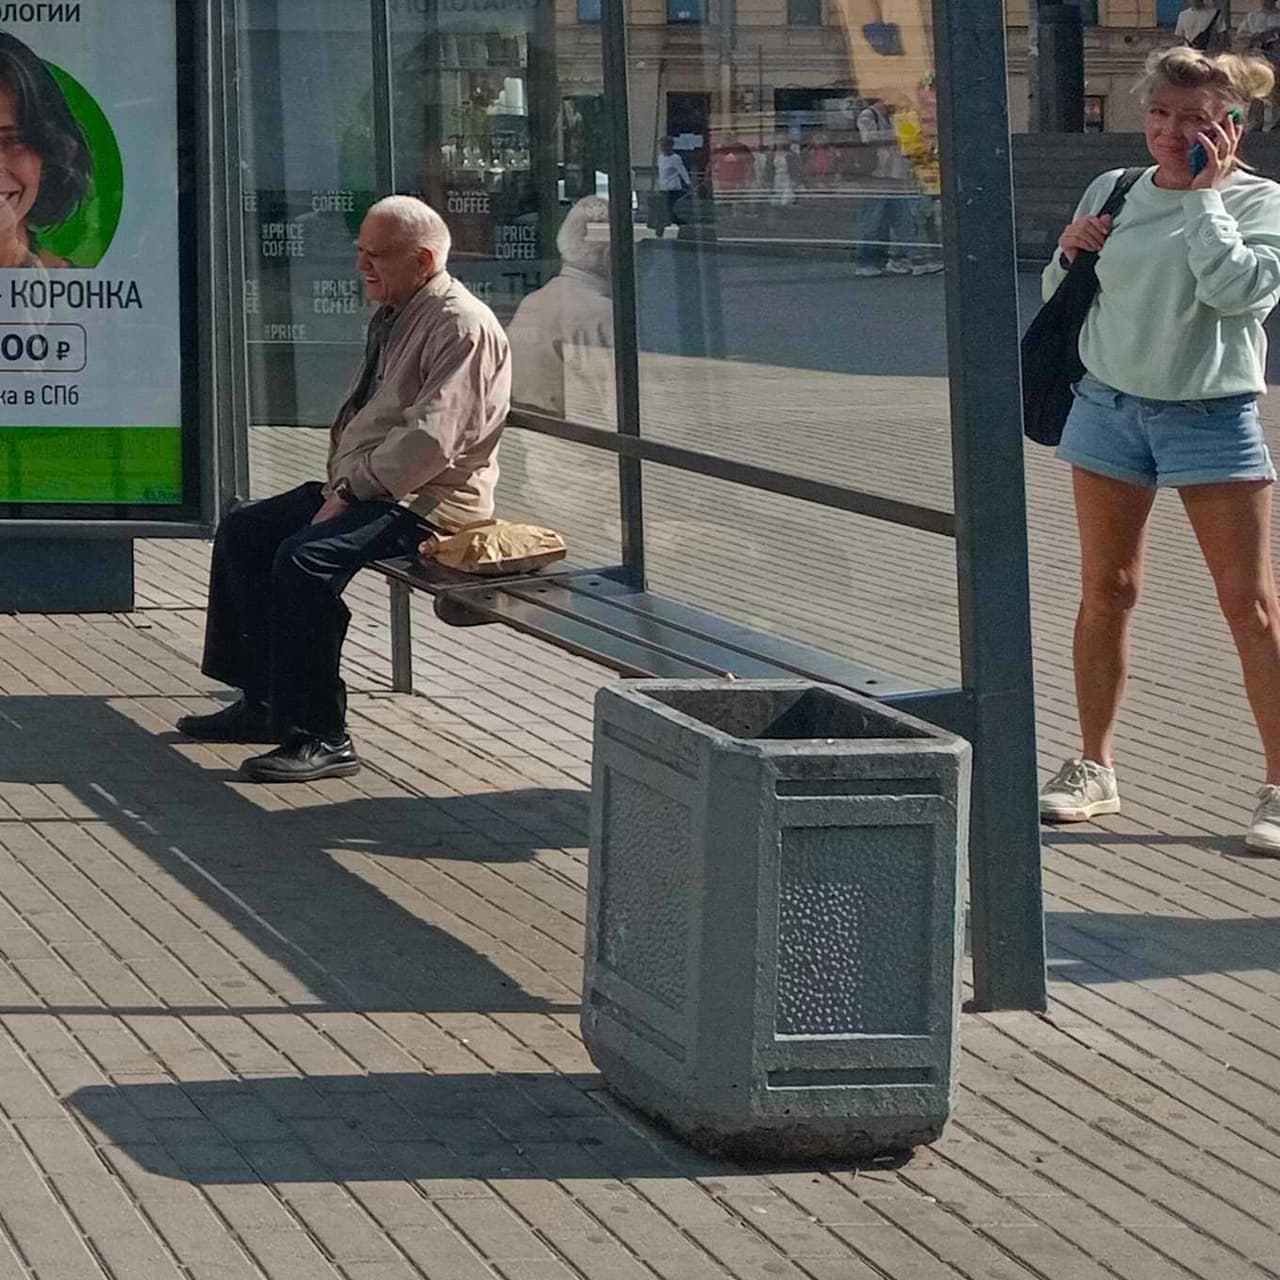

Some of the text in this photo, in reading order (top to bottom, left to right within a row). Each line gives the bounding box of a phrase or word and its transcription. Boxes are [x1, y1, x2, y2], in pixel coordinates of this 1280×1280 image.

[311, 196, 355, 212] COFFEE
[447, 197, 491, 214] COFFEE
[269, 223, 305, 239] PRICE
[501, 225, 537, 241] PRICE
[262, 240, 305, 256] COFFEE
[495, 242, 536, 259] COFFEE
[10, 279, 144, 309] КОРОНКА
[321, 279, 358, 297] PRICE
[313, 297, 357, 314] COFFEE
[270, 324, 306, 340] PRICE
[24, 389, 35, 405] в
[41, 384, 79, 405] СПб
